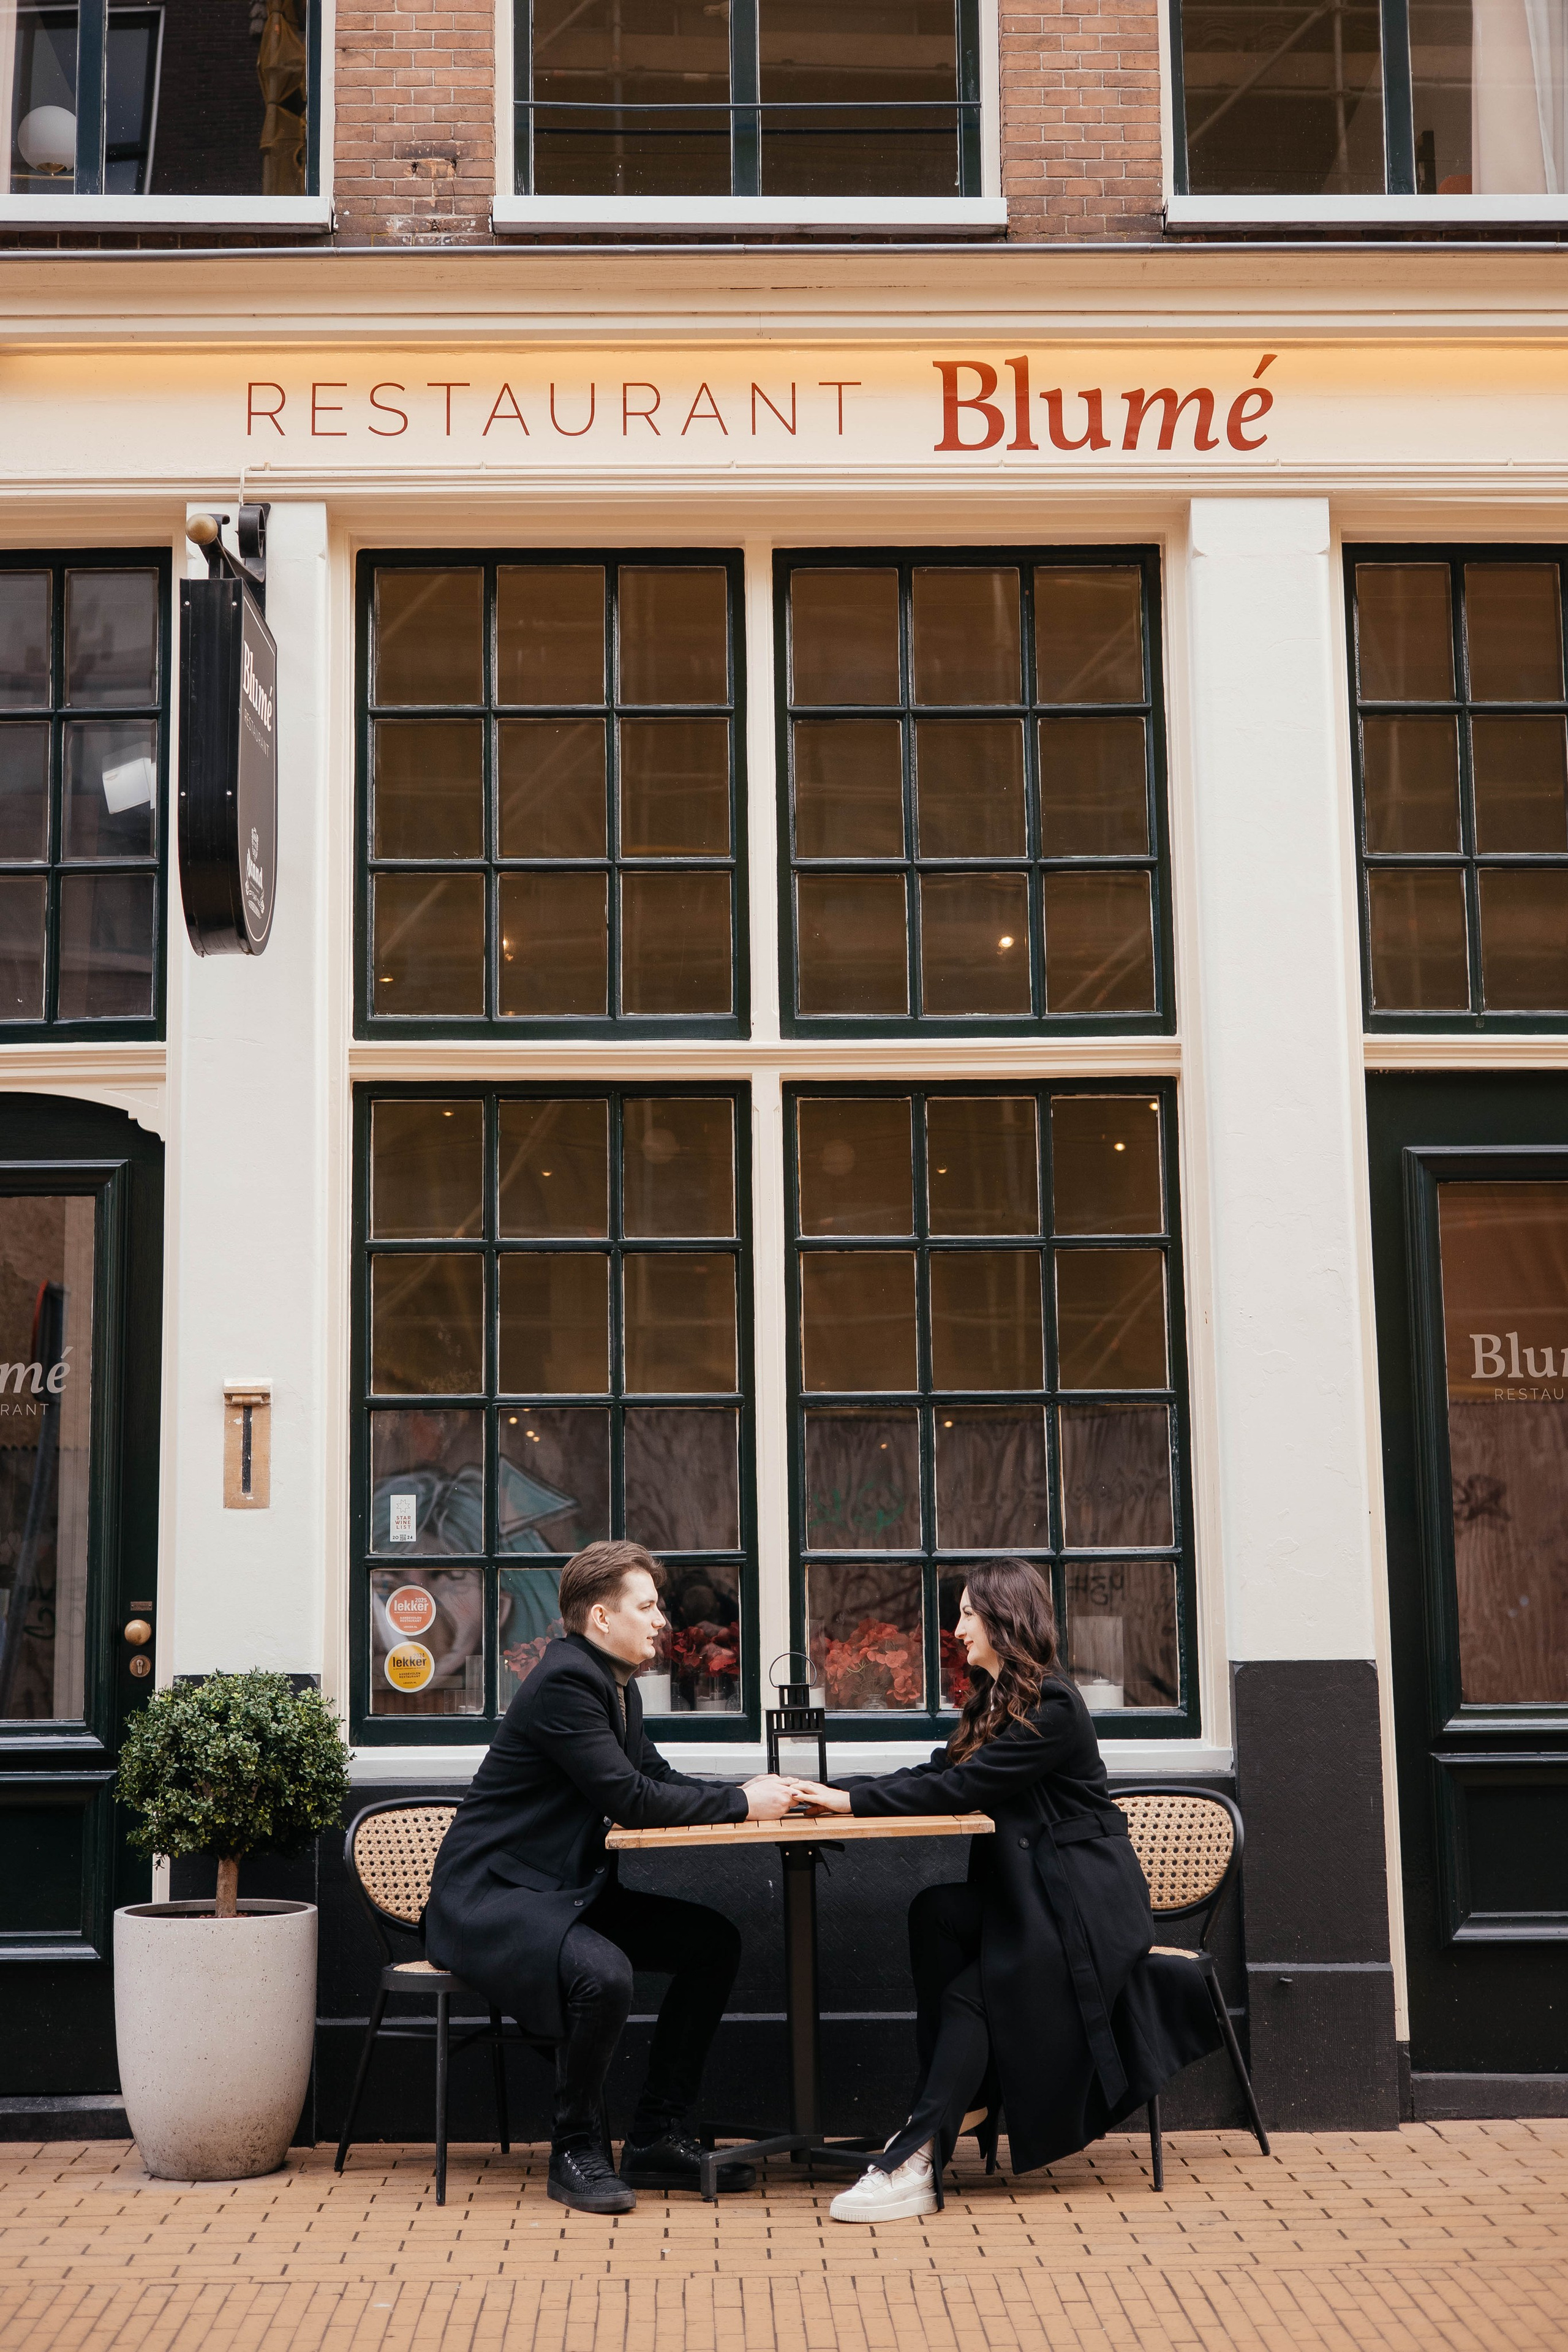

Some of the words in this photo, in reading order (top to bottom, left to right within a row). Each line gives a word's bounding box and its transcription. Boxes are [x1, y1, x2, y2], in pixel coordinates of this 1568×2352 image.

[246, 381, 862, 437] RESTAURANT
[932, 353, 1278, 452] Blumé
[243, 640, 273, 732] Blumé
[244, 708, 270, 758] RESTAURANT
[247, 848, 263, 889] Brand
[1469, 1331, 1568, 1379] Blu
[394, 1600, 429, 1611] lekker
[393, 1656, 427, 1667] lekker
